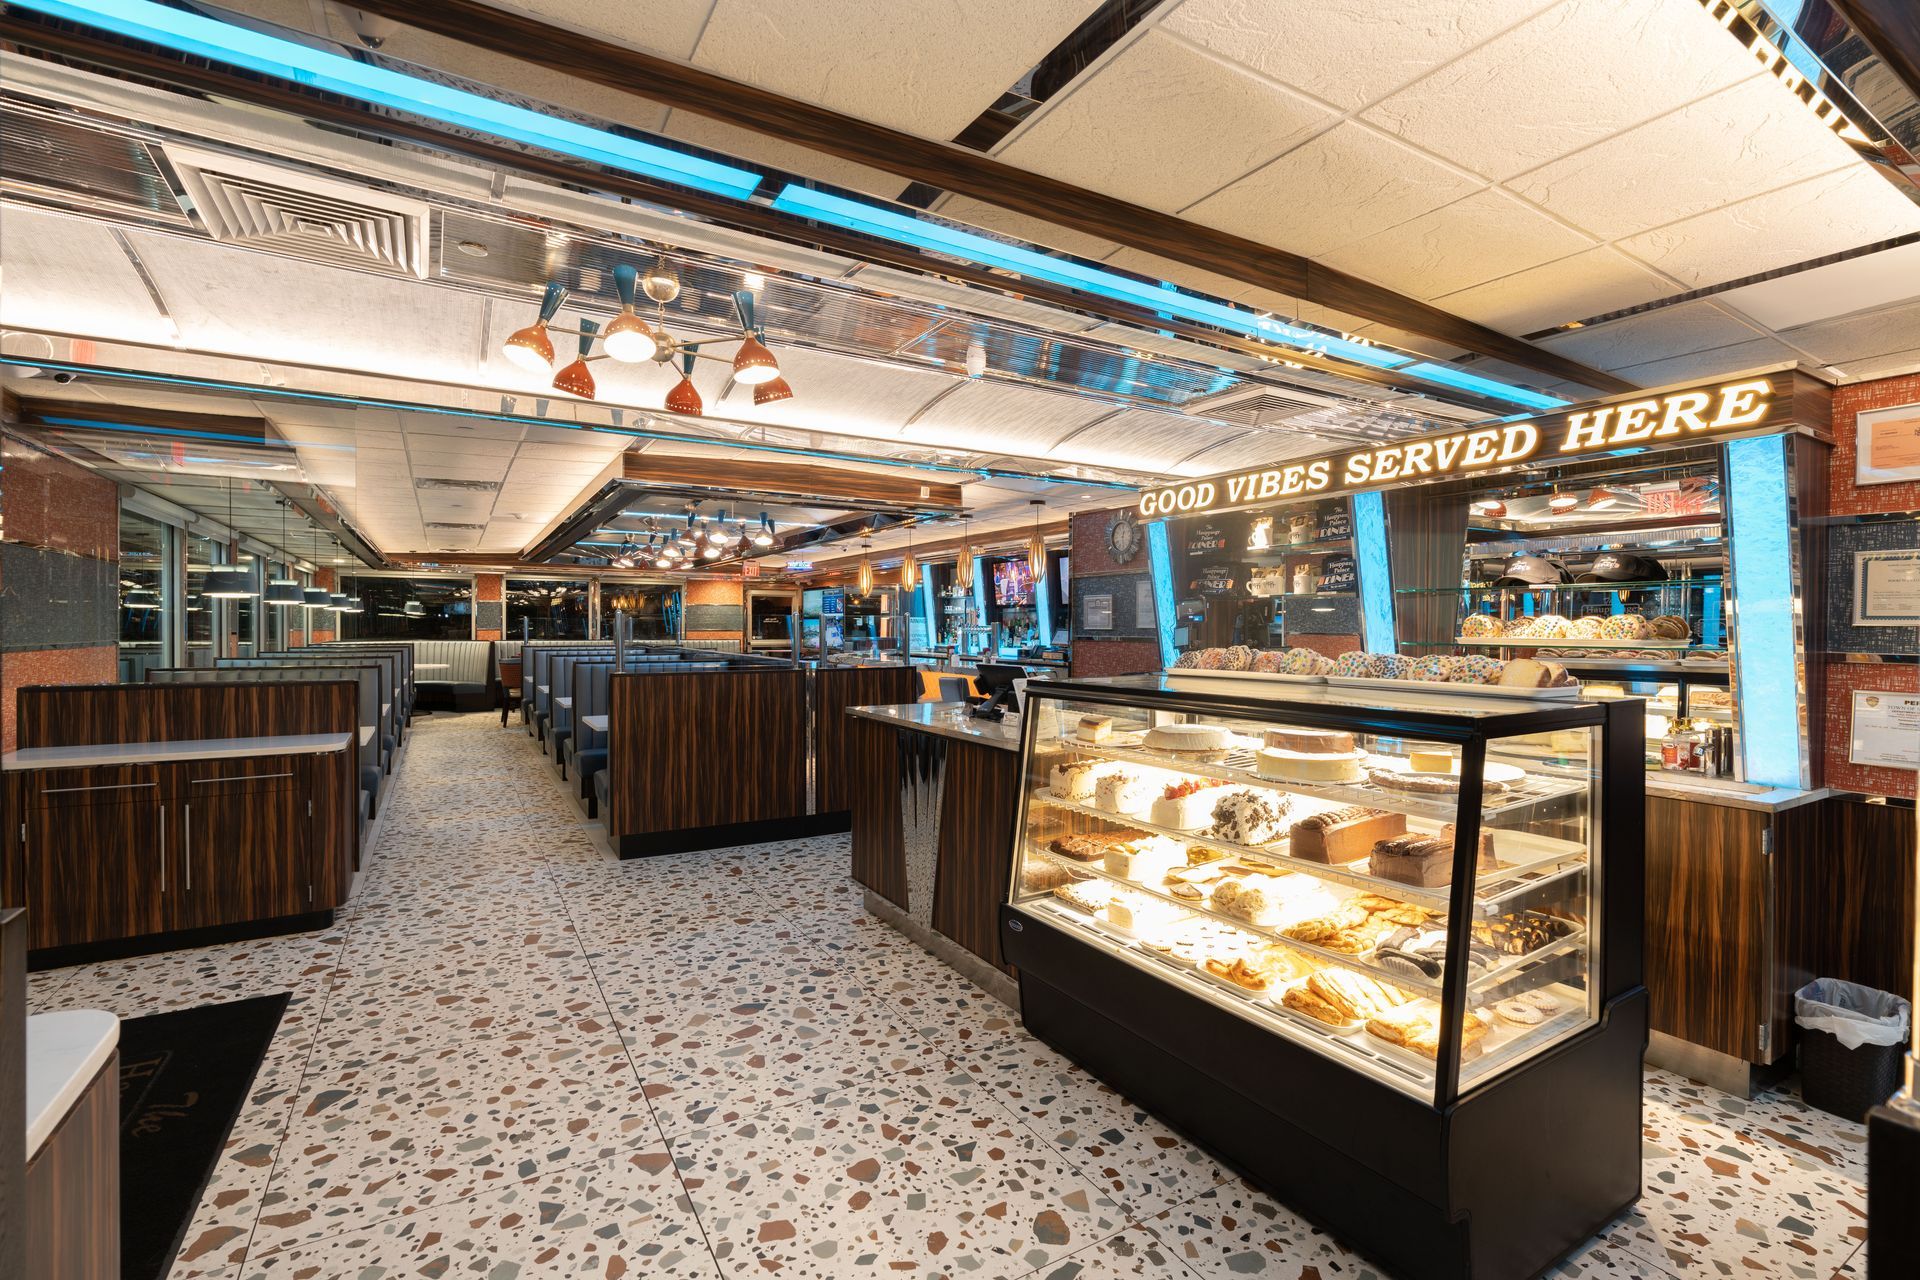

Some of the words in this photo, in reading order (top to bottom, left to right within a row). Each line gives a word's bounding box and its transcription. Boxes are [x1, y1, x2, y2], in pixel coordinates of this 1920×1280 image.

[1140, 483, 1215, 516] GOOD
[1227, 461, 1330, 503] VIBES
[1344, 424, 1538, 485] SERVED
[1560, 381, 1771, 450] HERE
[744, 566, 758, 576] EXIT
